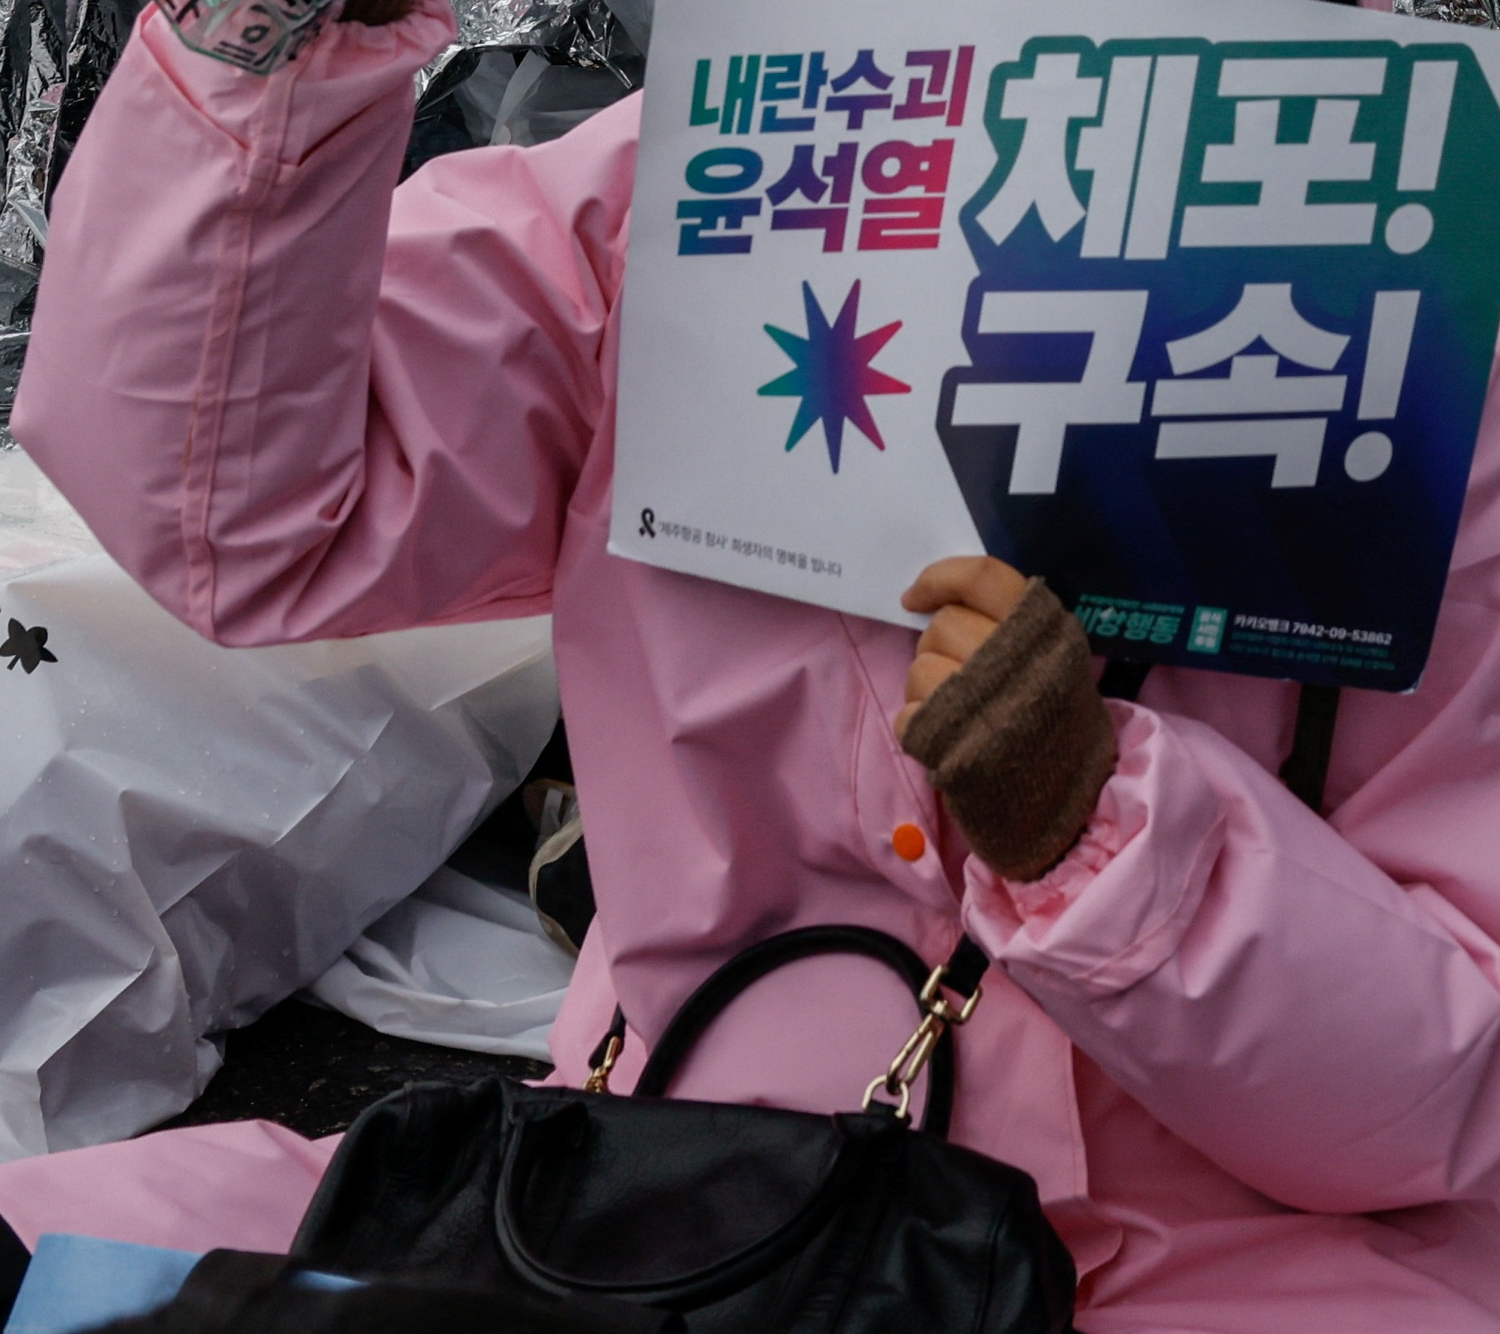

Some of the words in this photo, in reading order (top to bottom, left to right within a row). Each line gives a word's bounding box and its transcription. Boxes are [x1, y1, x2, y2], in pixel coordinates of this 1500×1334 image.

[688, 44, 976, 136] 내란수괴
[975, 51, 1460, 262] 체포!
[674, 138, 956, 257] 윤석열
[950, 281, 1424, 496] 구속!
